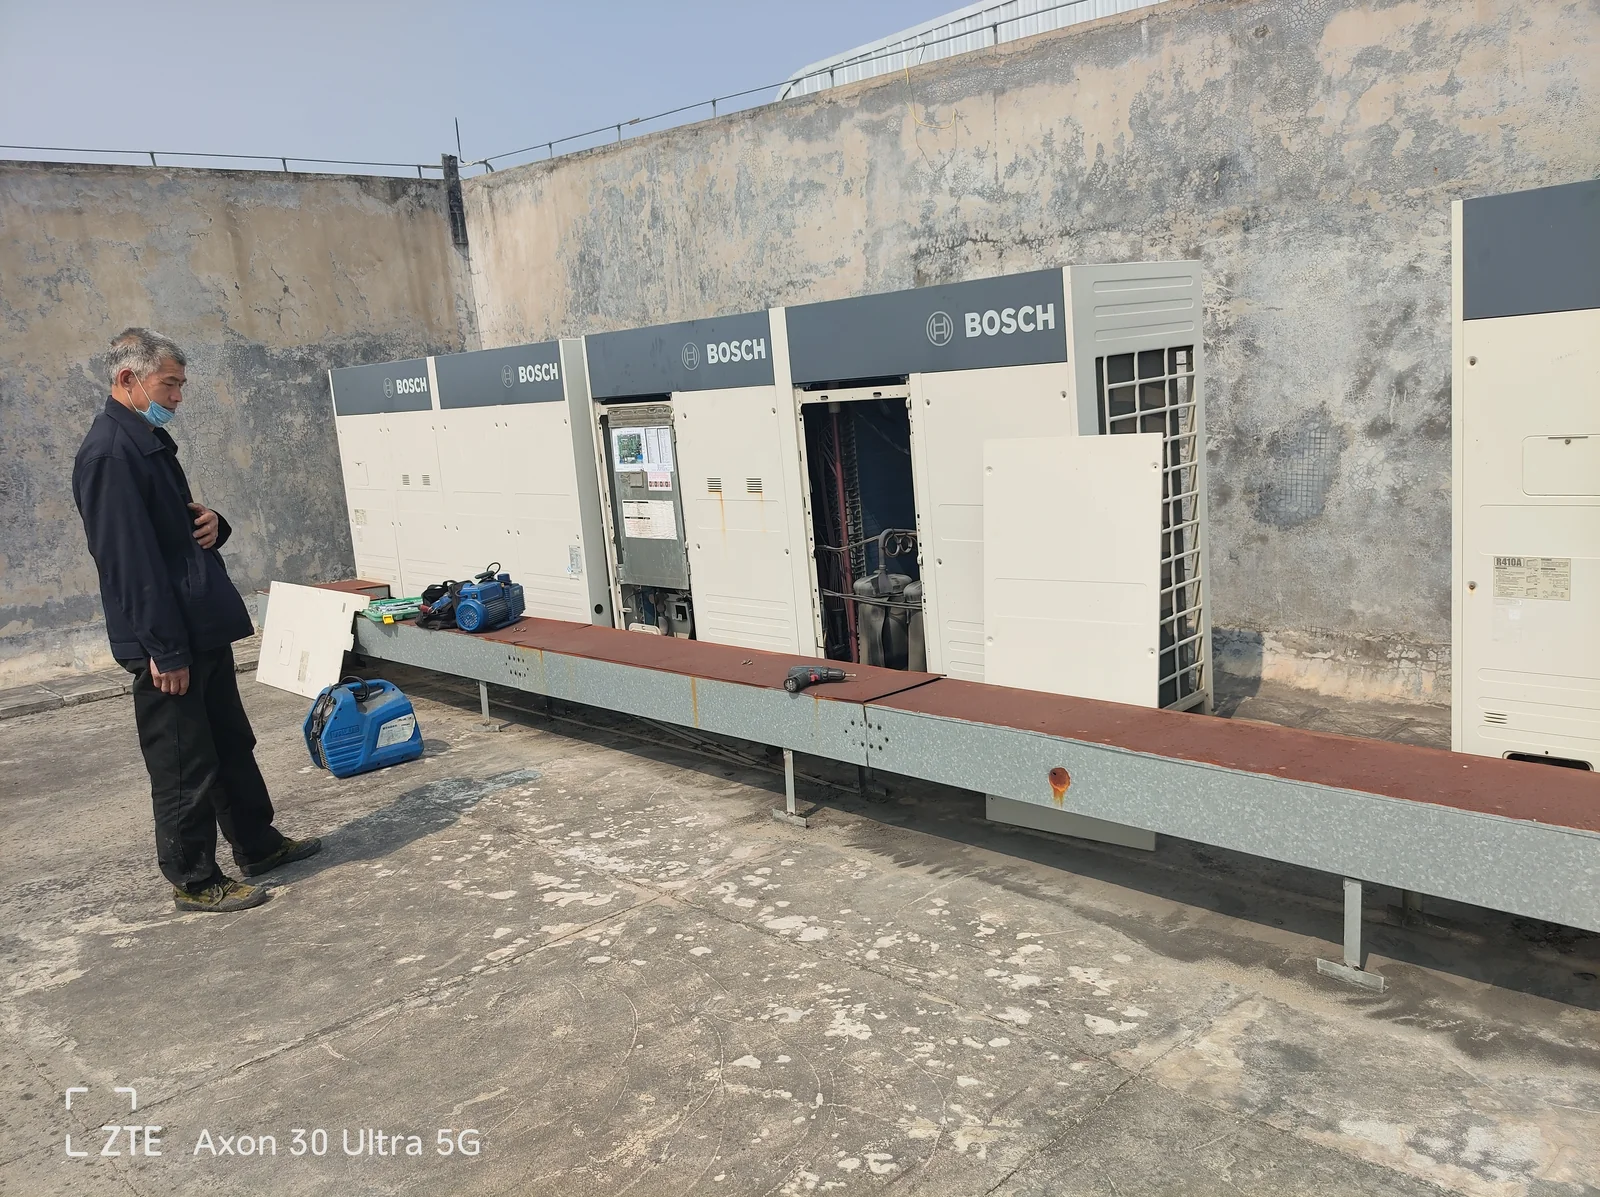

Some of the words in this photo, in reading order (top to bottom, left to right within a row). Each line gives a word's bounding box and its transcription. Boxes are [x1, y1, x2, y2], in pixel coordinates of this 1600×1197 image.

[964, 303, 1055, 338] BOSCH
[706, 338, 766, 364] BOSCH
[518, 362, 559, 383] BOSCH
[396, 377, 428, 395] BOSCH
[1496, 557, 1522, 567] R410A
